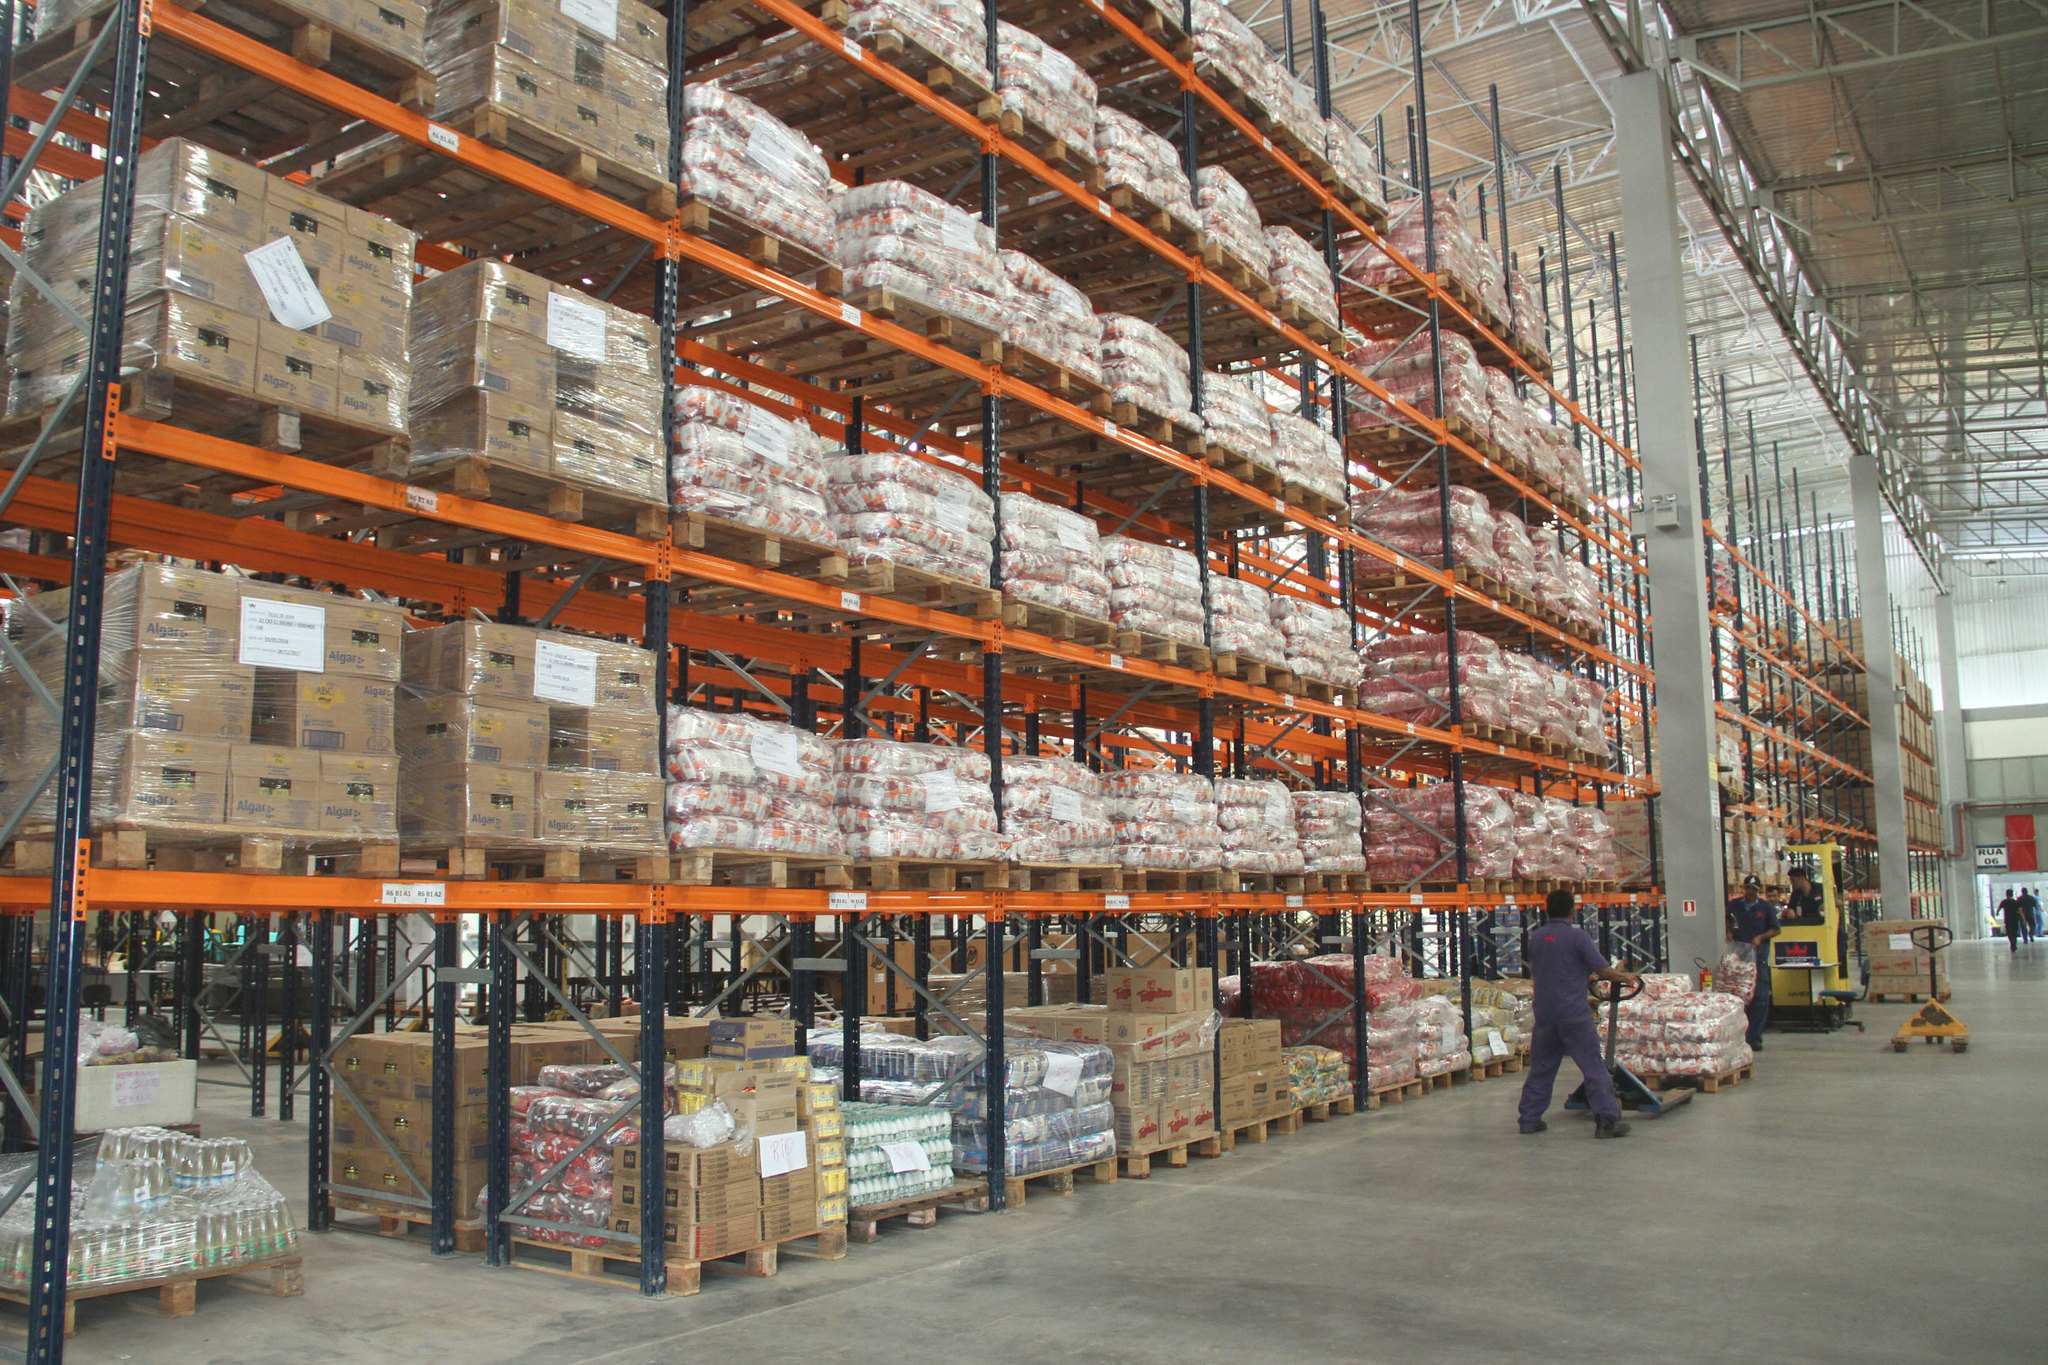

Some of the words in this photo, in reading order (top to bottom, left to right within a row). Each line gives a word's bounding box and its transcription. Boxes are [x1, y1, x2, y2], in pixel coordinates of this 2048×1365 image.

[262, 373, 289, 388] Algar
[343, 395, 369, 410] Algar
[147, 623, 178, 637] Algar
[328, 650, 356, 664] Algar
[363, 685, 386, 697] Algar
[237, 800, 265, 814] Algar
[325, 806, 352, 819] Algar
[471, 813, 496, 825] Algar
[548, 820, 570, 831] Algar
